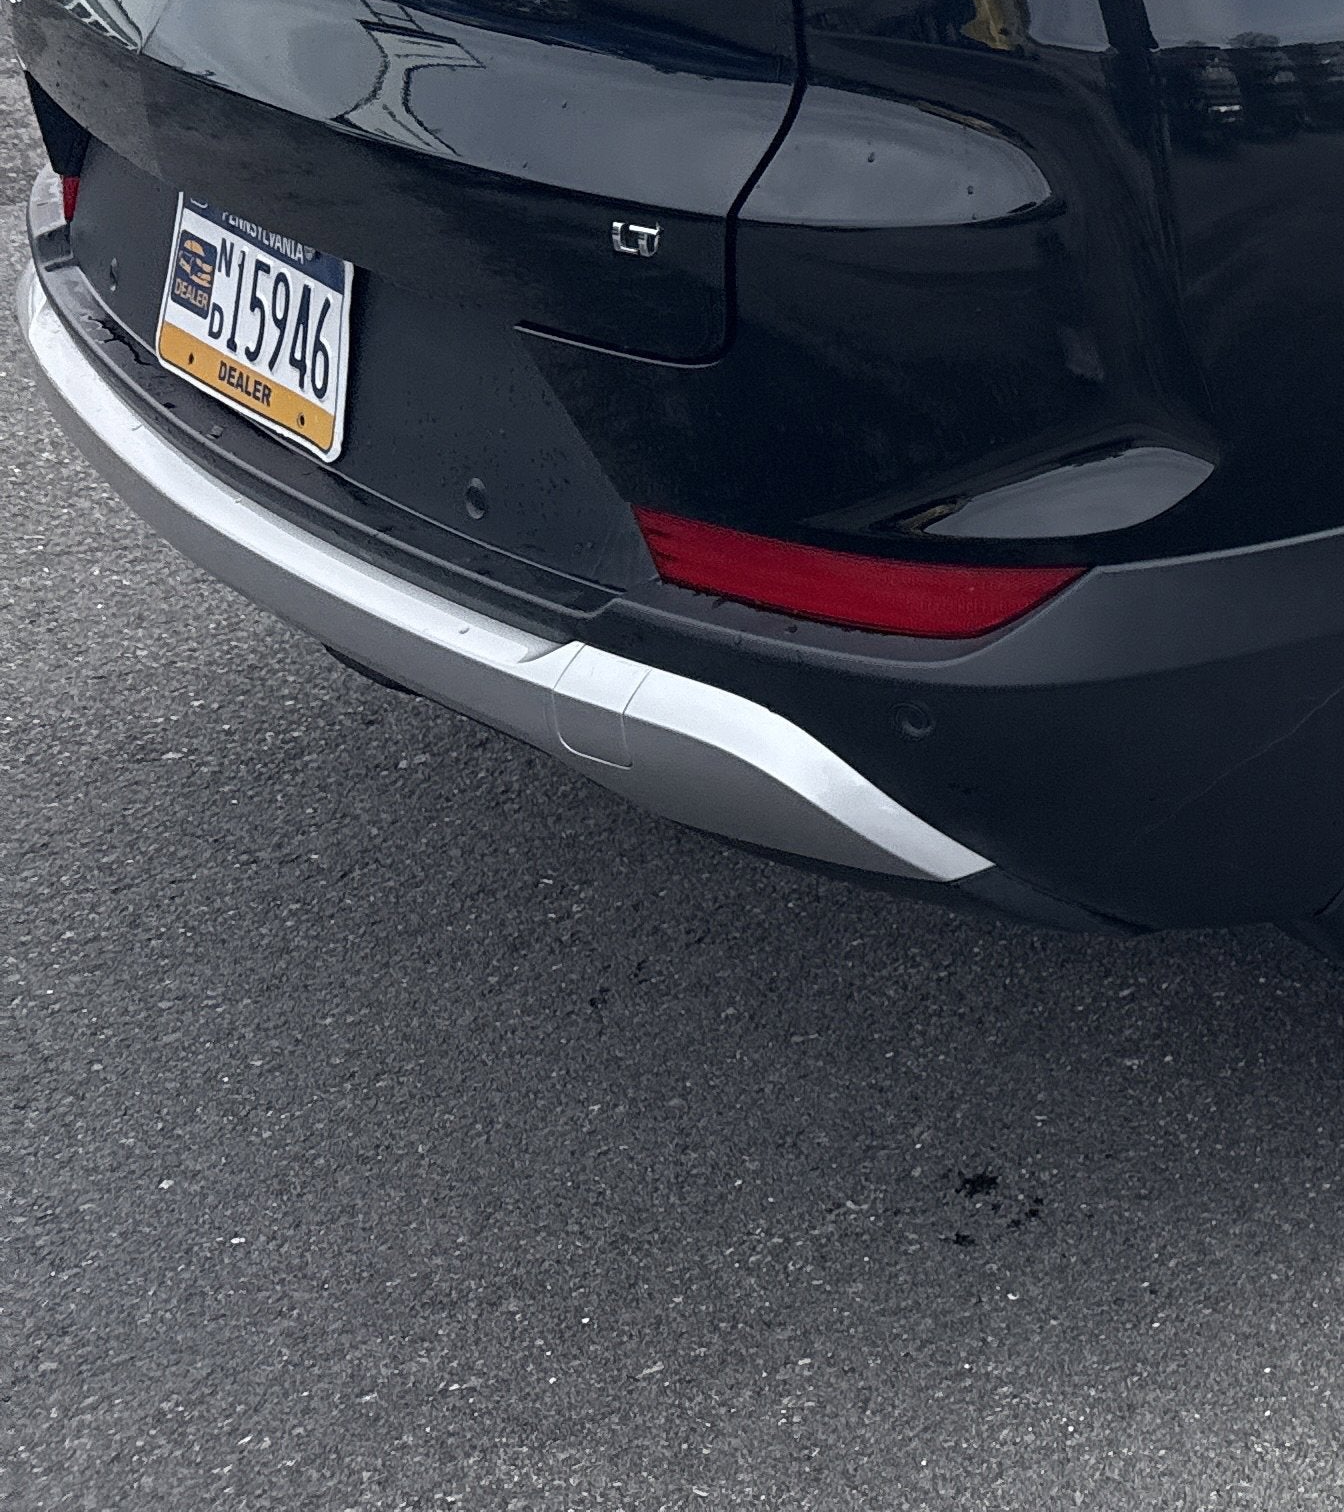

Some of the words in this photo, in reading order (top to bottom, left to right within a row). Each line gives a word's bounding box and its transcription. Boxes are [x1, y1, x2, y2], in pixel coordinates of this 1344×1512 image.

[611, 221, 661, 257] LT
[174, 277, 209, 310] DEALER
[217, 360, 272, 407] DEALER
